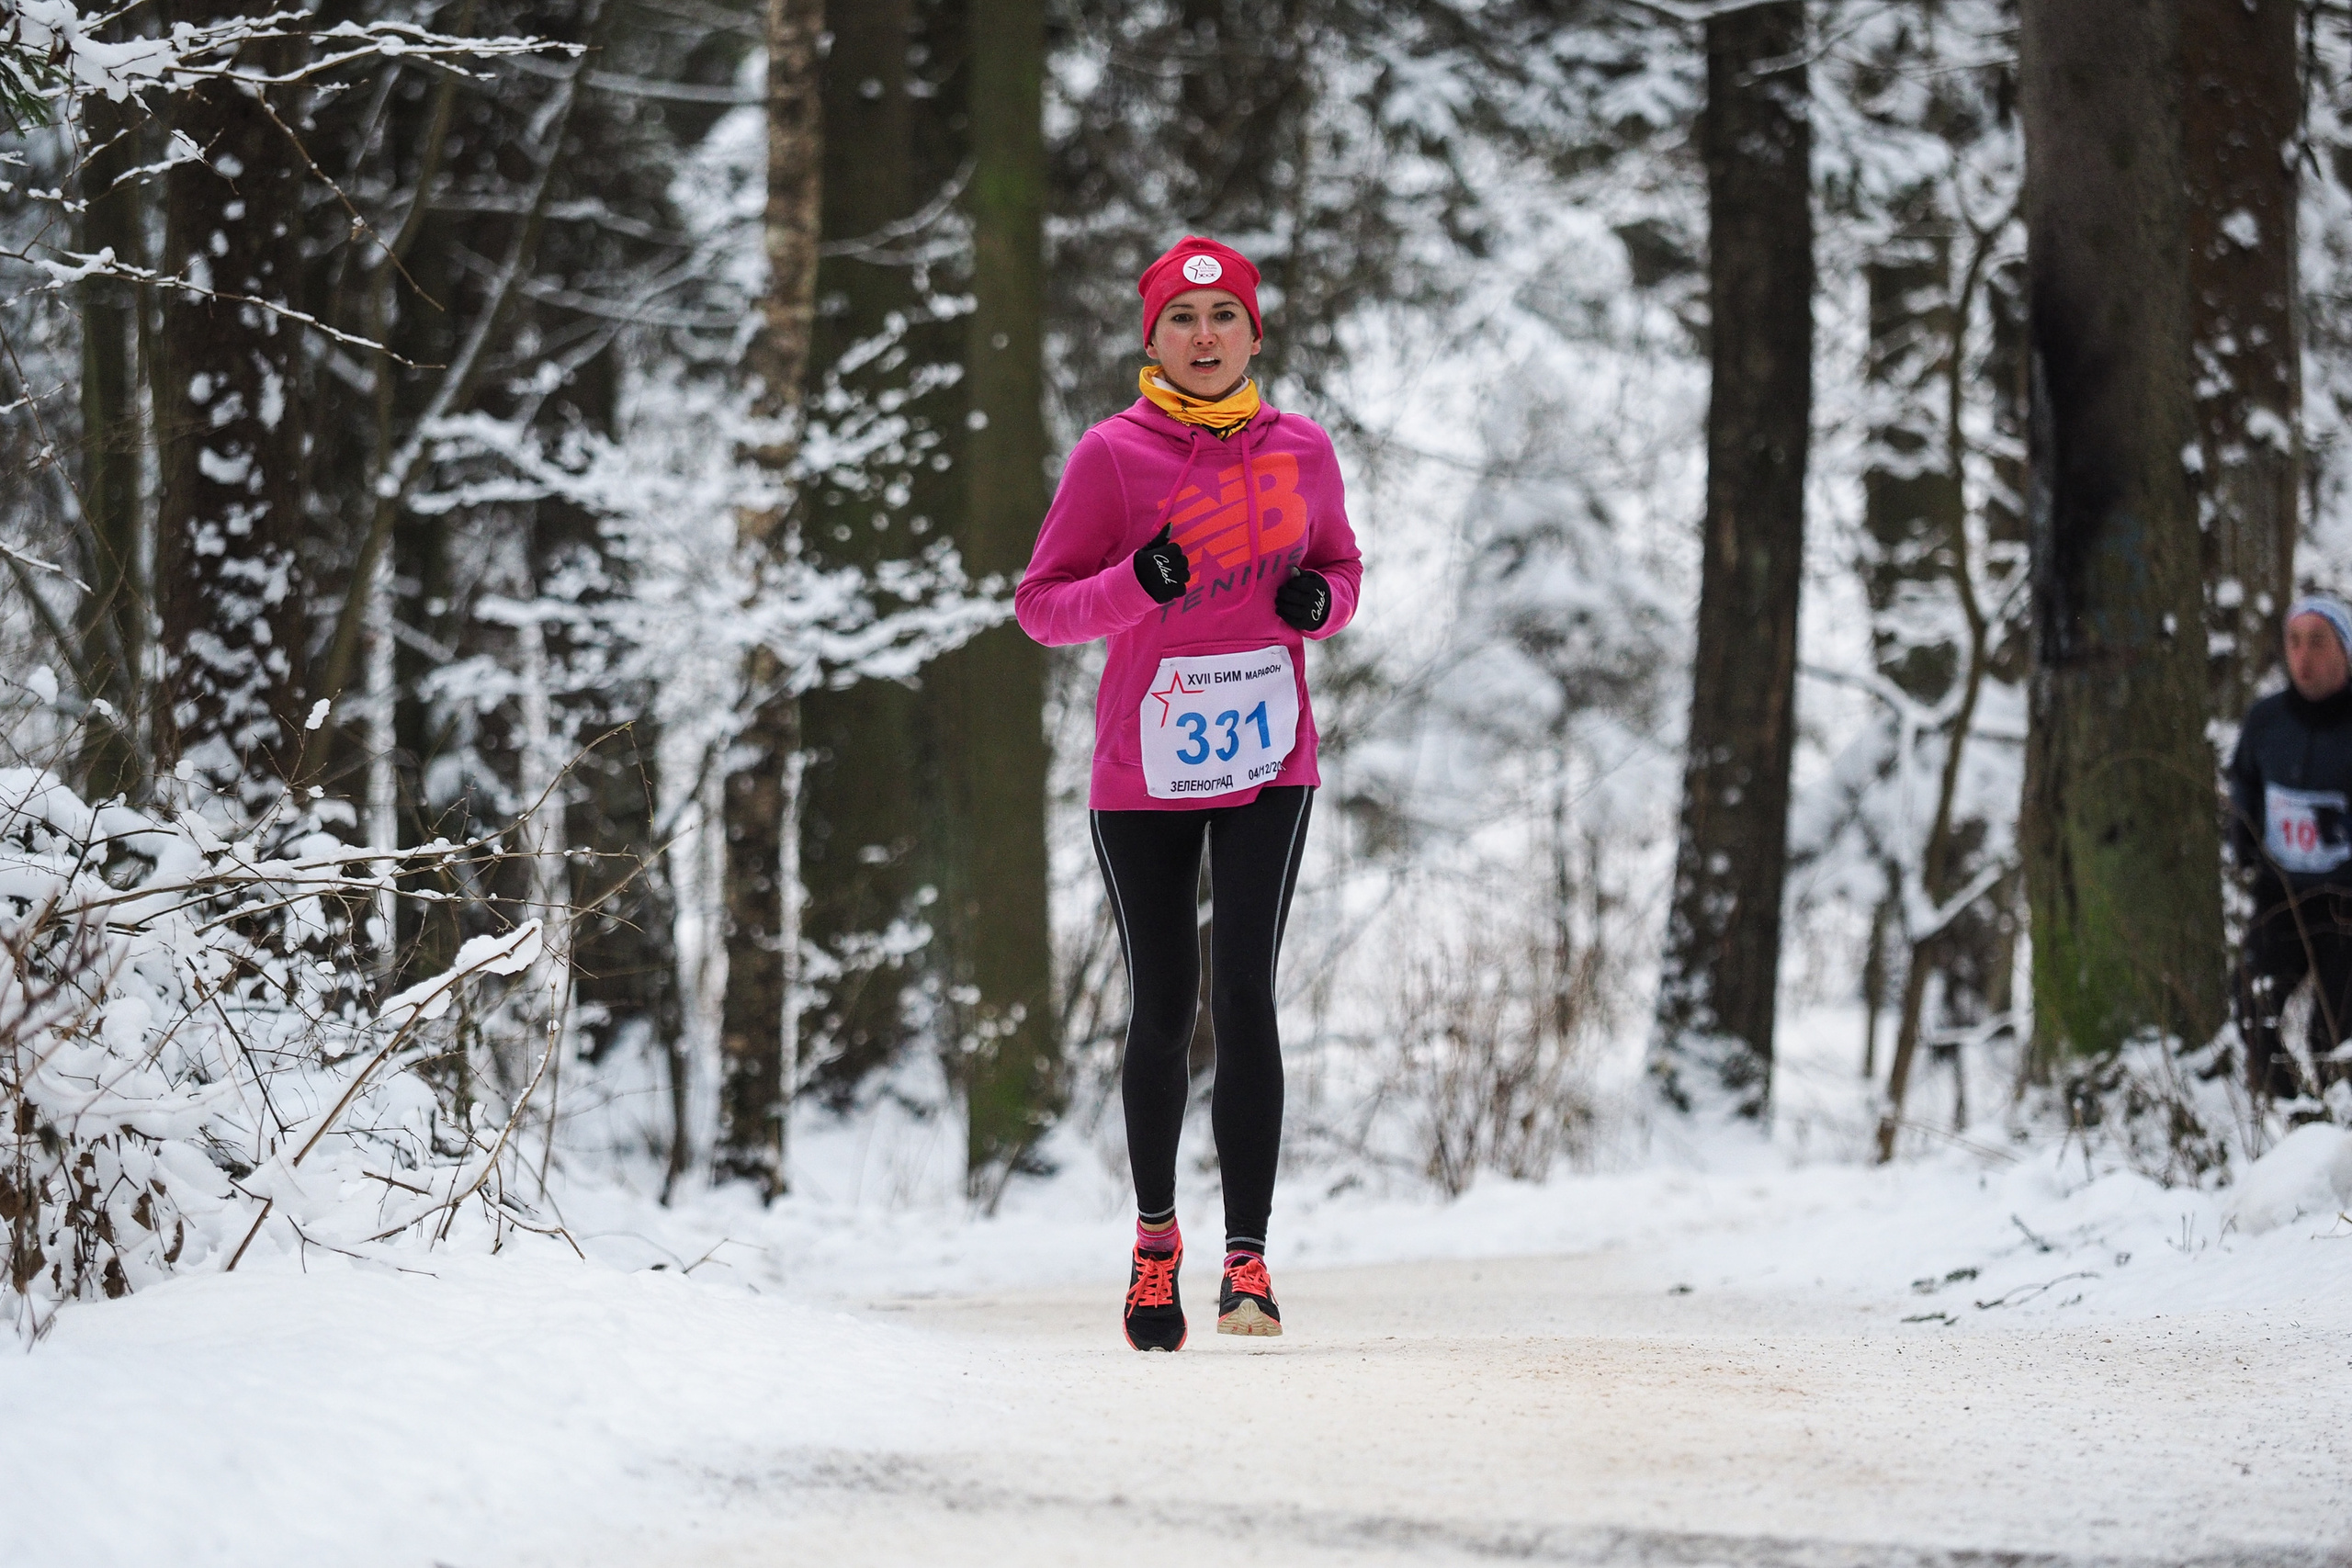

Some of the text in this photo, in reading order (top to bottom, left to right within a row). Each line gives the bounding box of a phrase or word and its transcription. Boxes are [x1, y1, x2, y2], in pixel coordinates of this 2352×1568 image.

[1160, 546, 1304, 624] TENNIS
[1187, 664, 1282, 685] XVII БИМ МАРАФОН
[1176, 701, 1271, 765] 331
[1170, 774, 1234, 792] ЗЕЛЕНОГРАД
